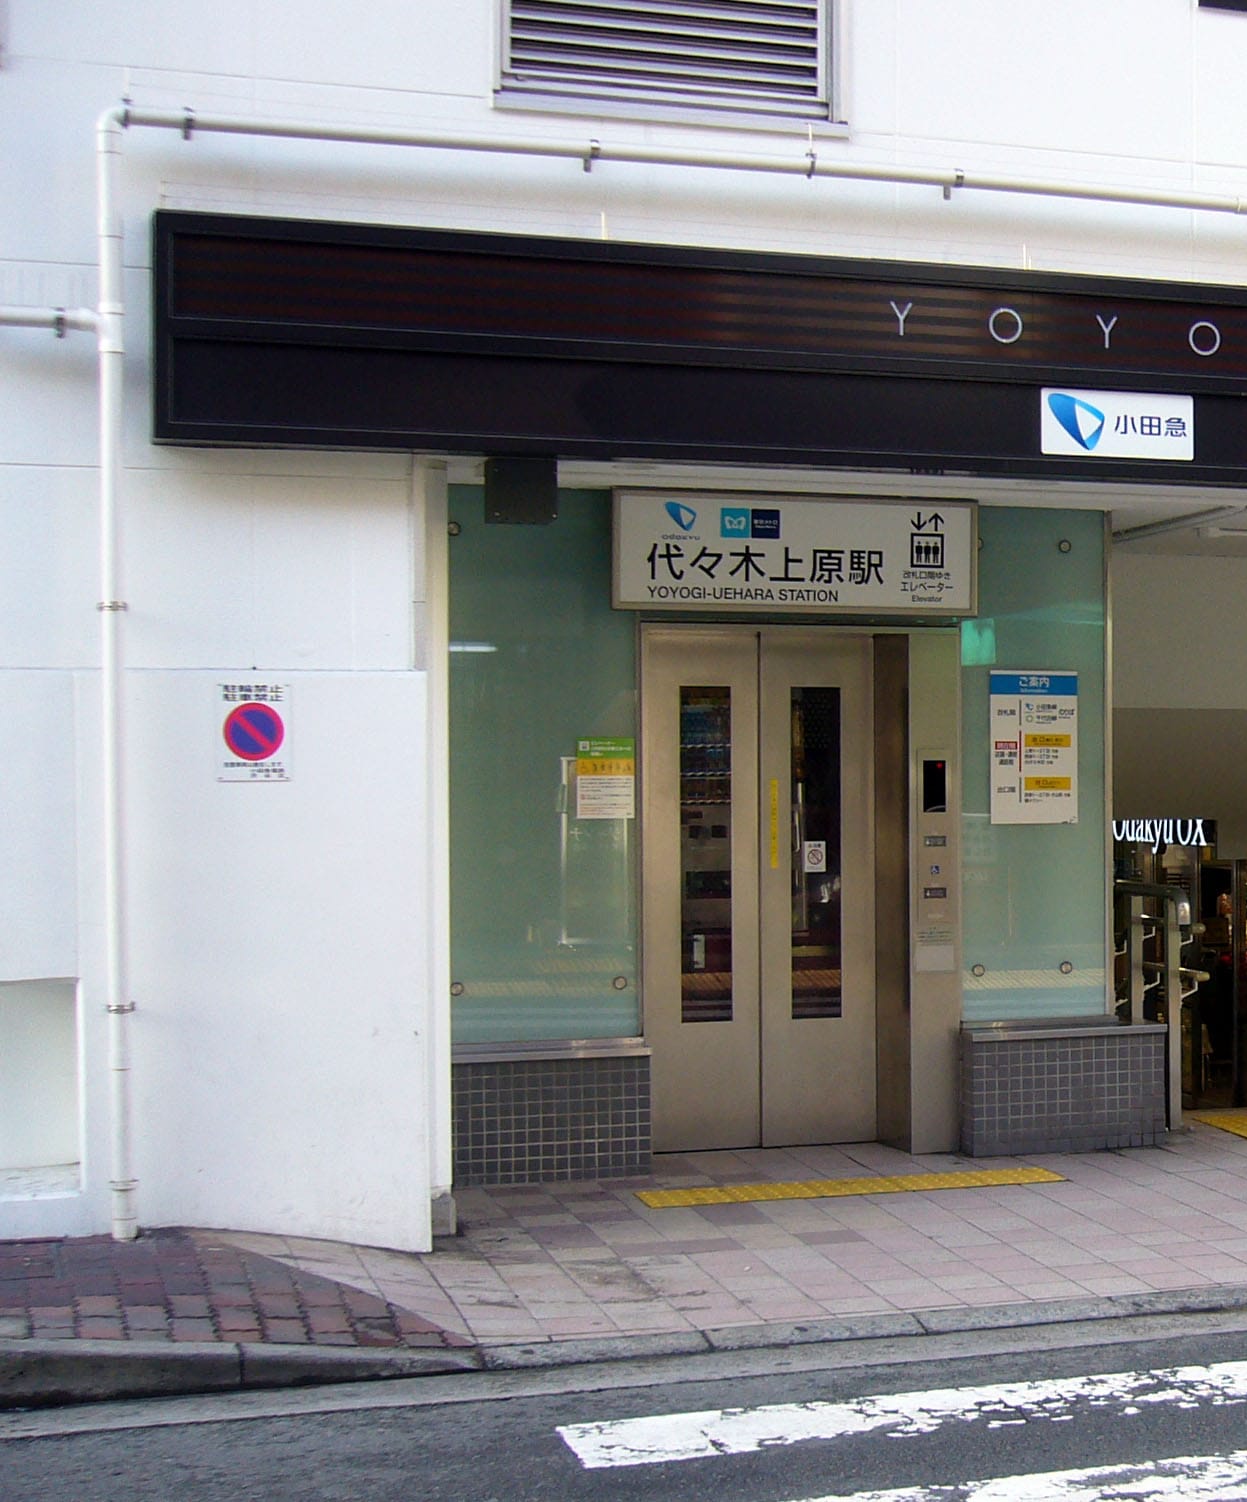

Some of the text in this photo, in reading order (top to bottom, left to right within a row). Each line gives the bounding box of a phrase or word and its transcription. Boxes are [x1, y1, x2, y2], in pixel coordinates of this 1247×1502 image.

[1114, 414, 1187, 437] 小田急
[647, 543, 884, 585] 代々木上原駅
[647, 586, 838, 602] YOYOGI-UEHARA STATION
[900, 581, 954, 592] エレベーター
[912, 594, 943, 603] Elevator
